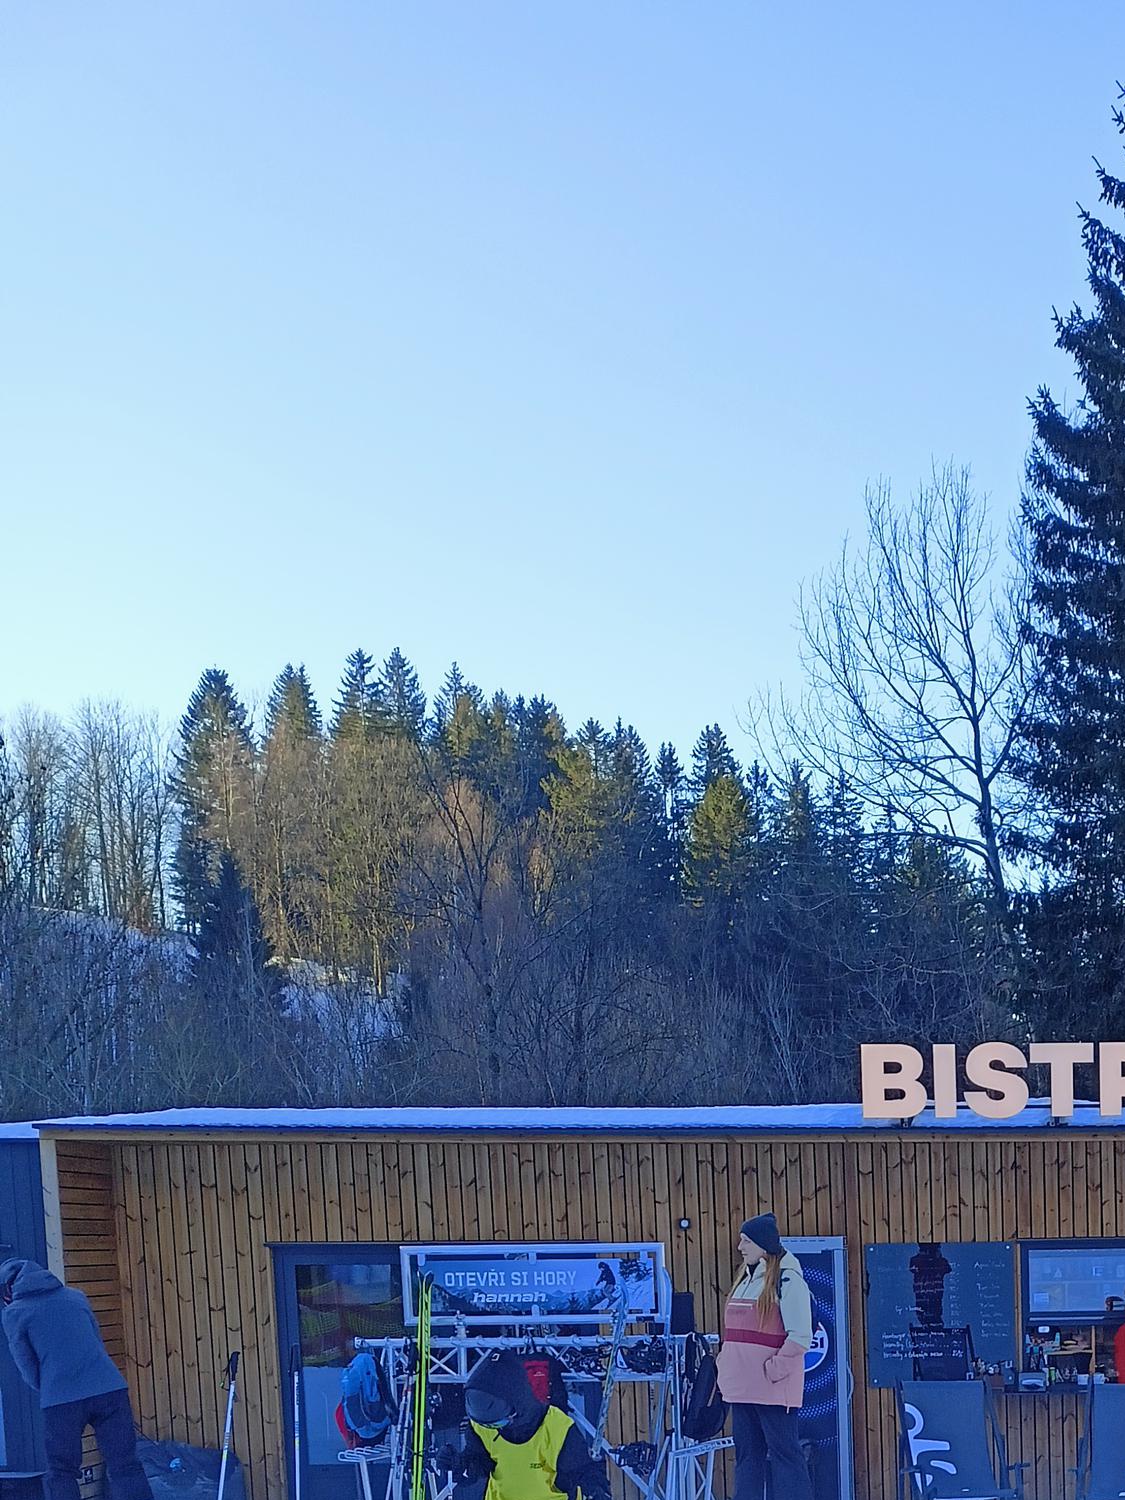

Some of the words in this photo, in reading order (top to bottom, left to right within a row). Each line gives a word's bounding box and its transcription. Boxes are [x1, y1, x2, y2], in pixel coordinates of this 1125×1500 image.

[444, 1269, 506, 1287] OTEVŘI
[511, 1271, 529, 1287] SI
[533, 1270, 577, 1286] HORY
